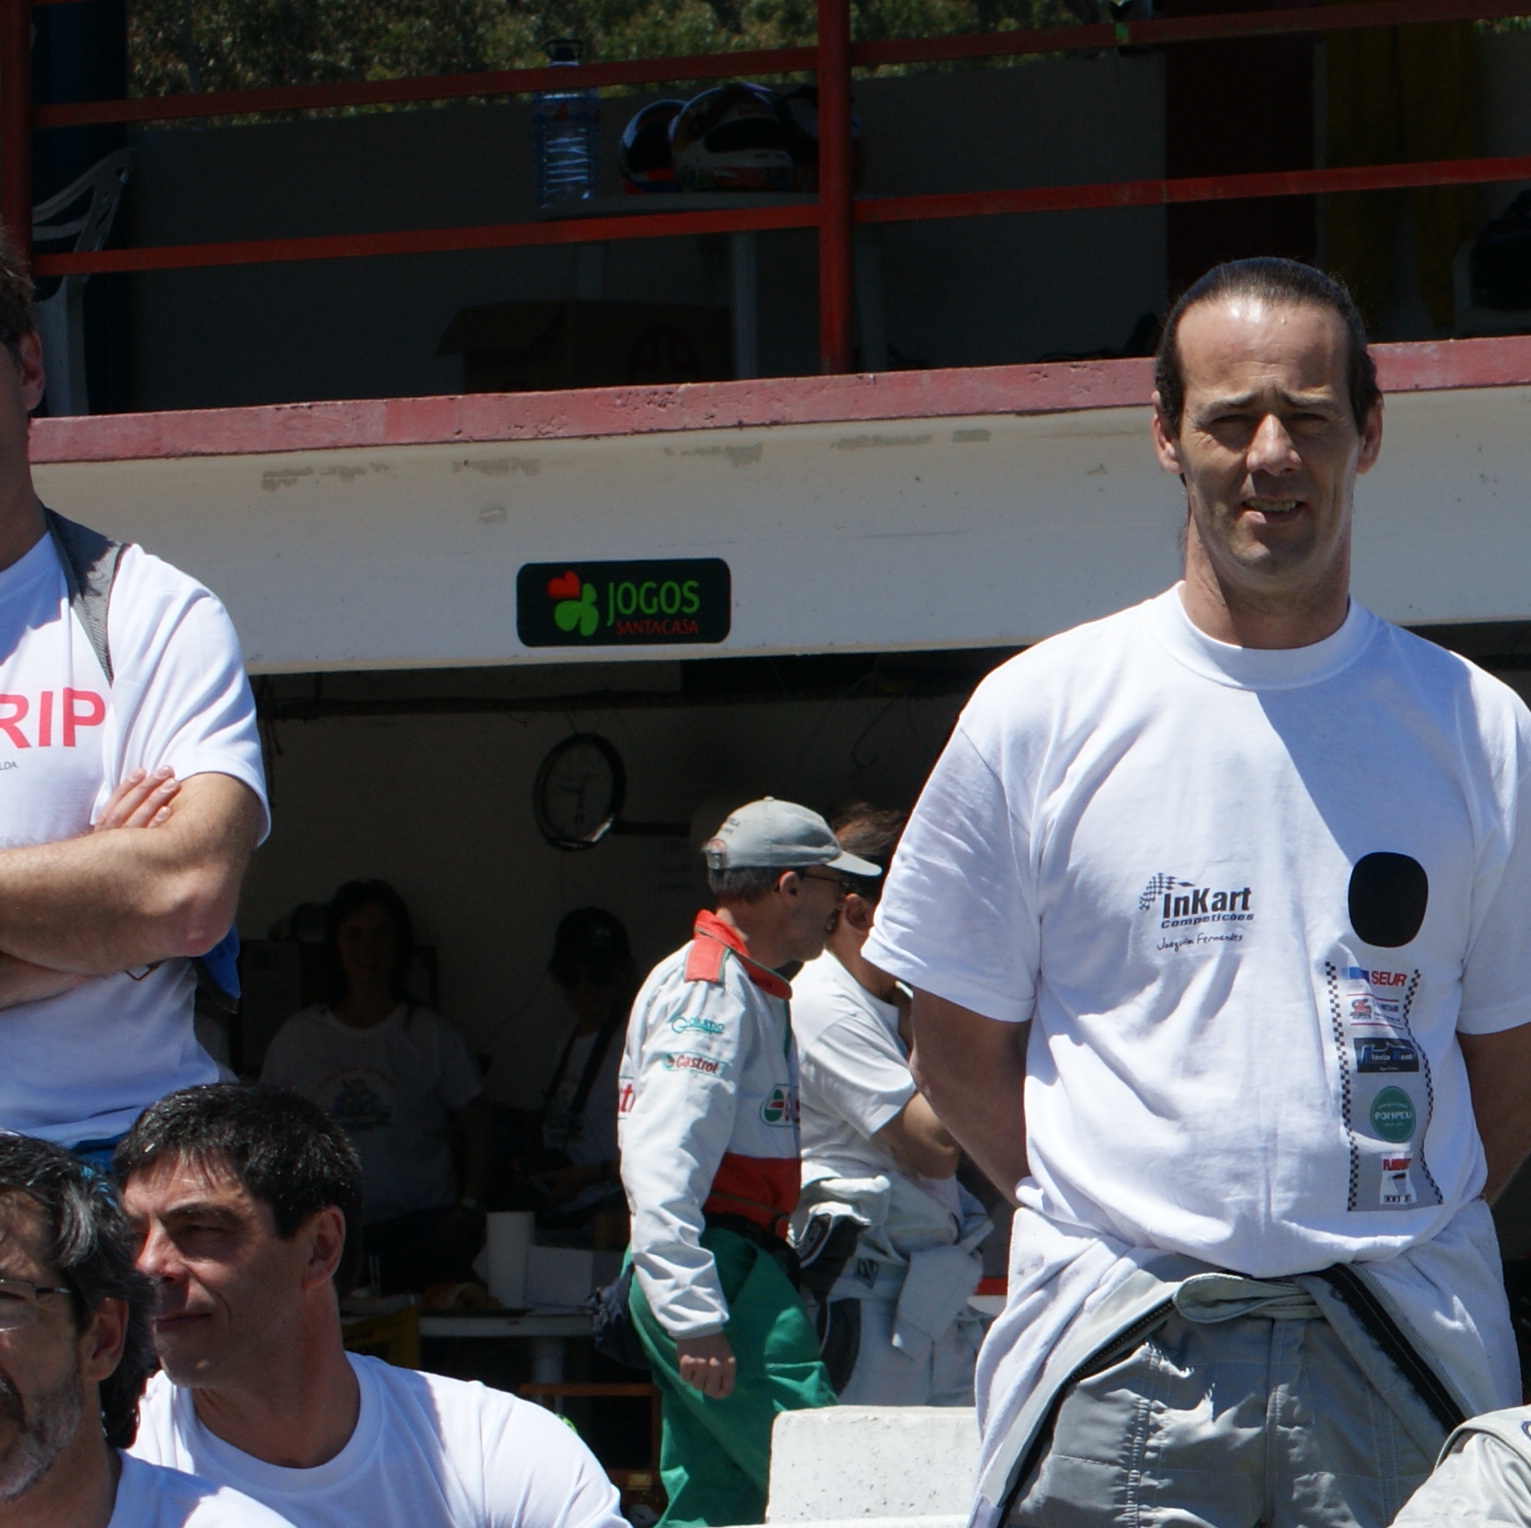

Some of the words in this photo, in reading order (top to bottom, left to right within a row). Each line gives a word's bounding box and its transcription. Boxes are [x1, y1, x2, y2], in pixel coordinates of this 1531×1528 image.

[607, 581, 700, 627] JOGOS
[1163, 887, 1252, 919] InKart
[1371, 970, 1407, 987] SEUR
[676, 1054, 719, 1074] Castrol
